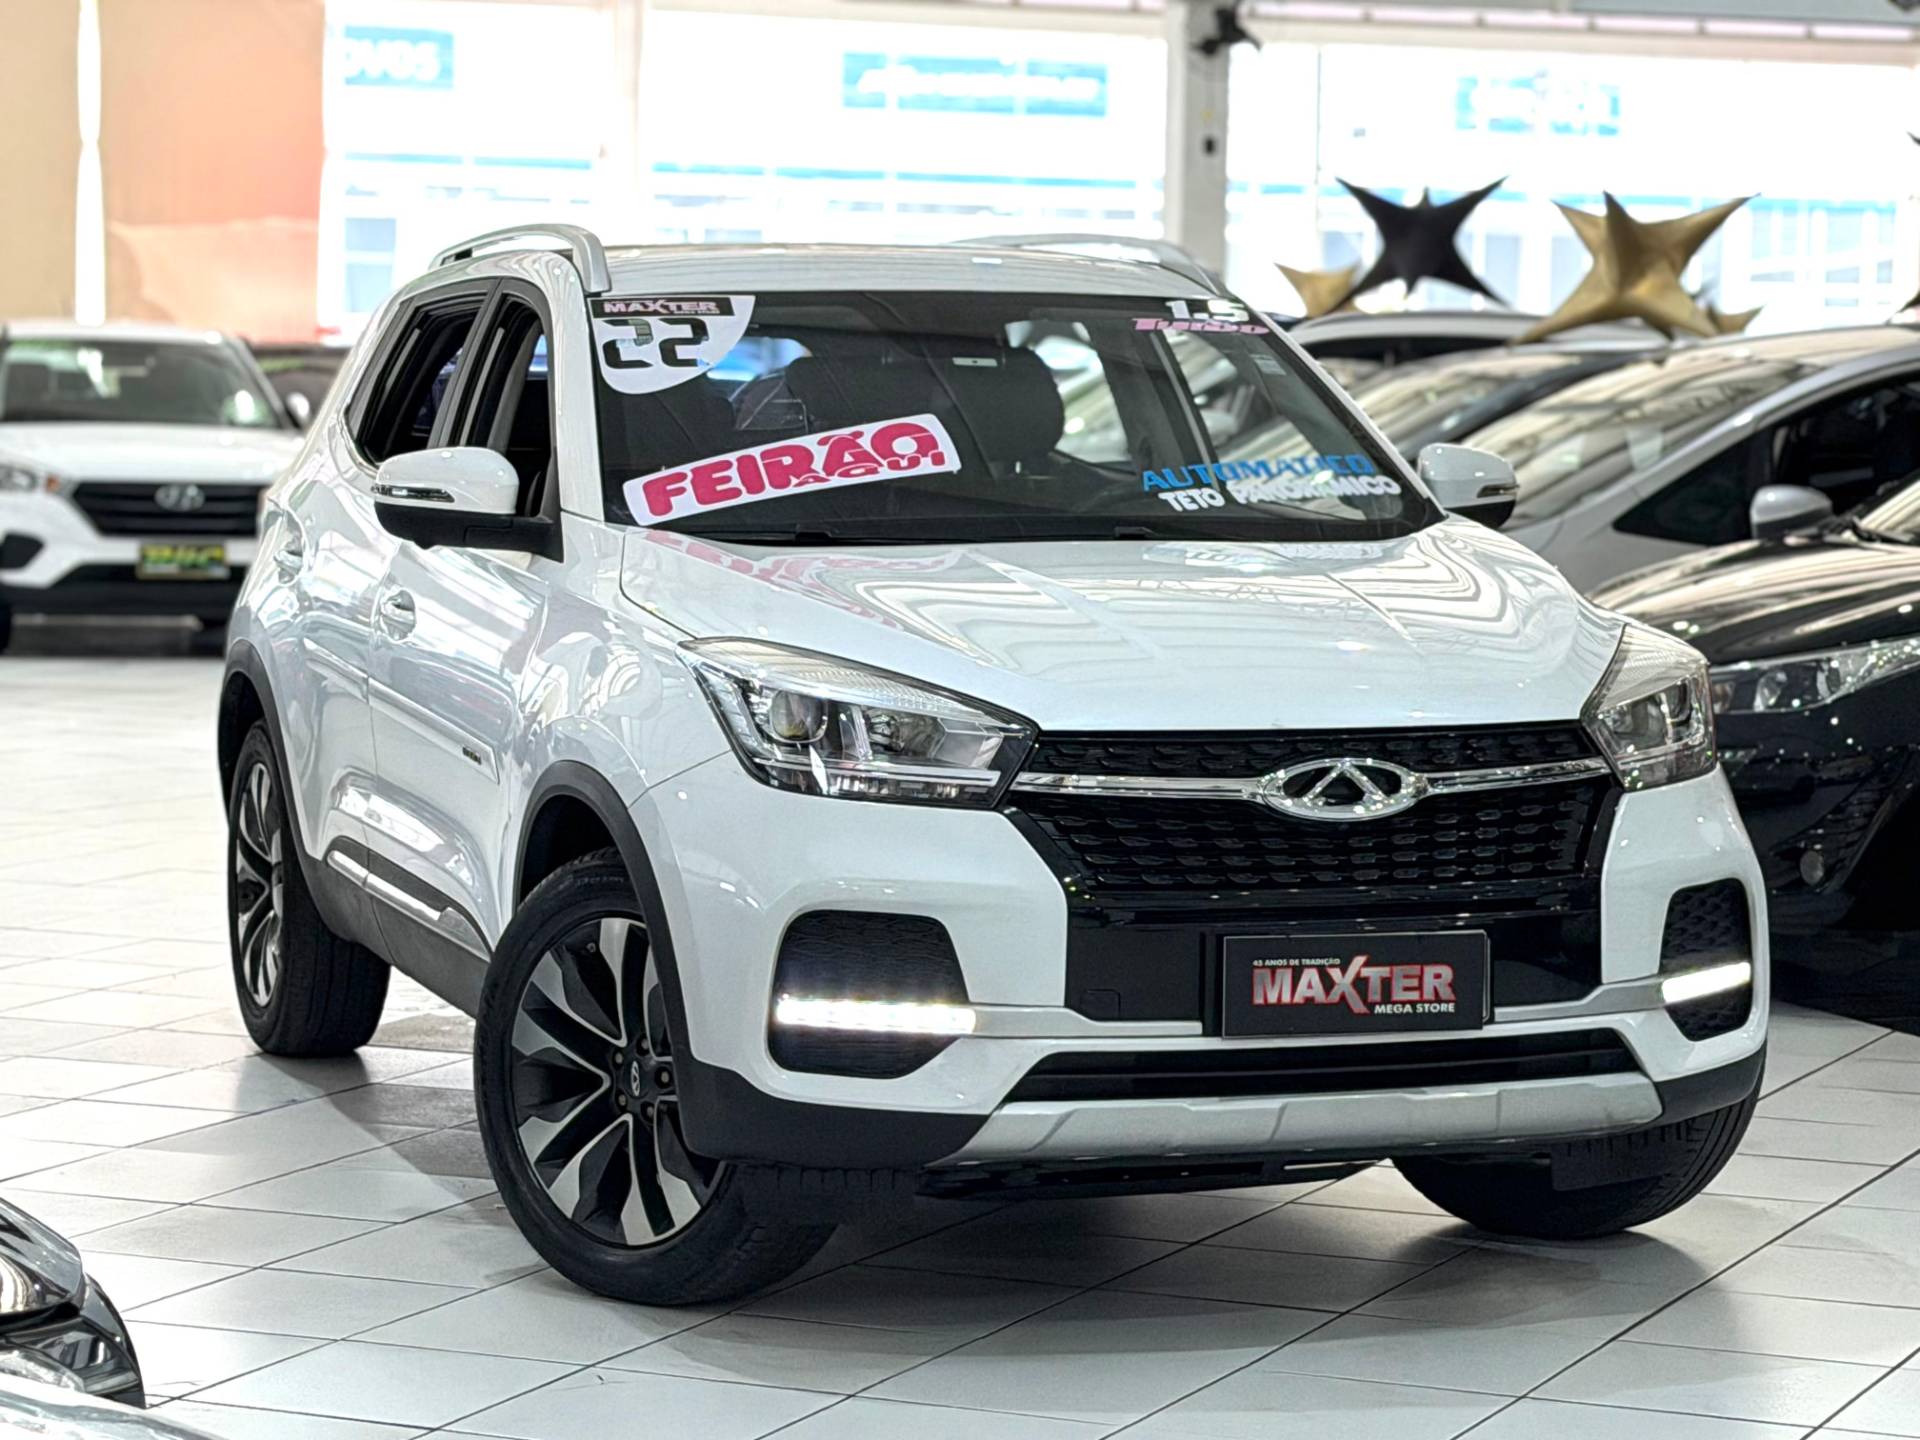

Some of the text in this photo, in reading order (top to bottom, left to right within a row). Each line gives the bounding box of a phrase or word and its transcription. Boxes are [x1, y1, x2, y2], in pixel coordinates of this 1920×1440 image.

[603, 300, 719, 314] MAXTER
[1165, 300, 1250, 322] 1.5
[602, 317, 710, 369] 22
[642, 422, 939, 517] FEIRÃO
[1158, 487, 1226, 513] TETO
[1265, 958, 1288, 967] ANOS
[1289, 958, 1300, 967] DE
[1301, 957, 1341, 967] TRADIÇÃO
[1252, 954, 1457, 1014] MAXTER
[1374, 1002, 1456, 1014] MEGA STORE
